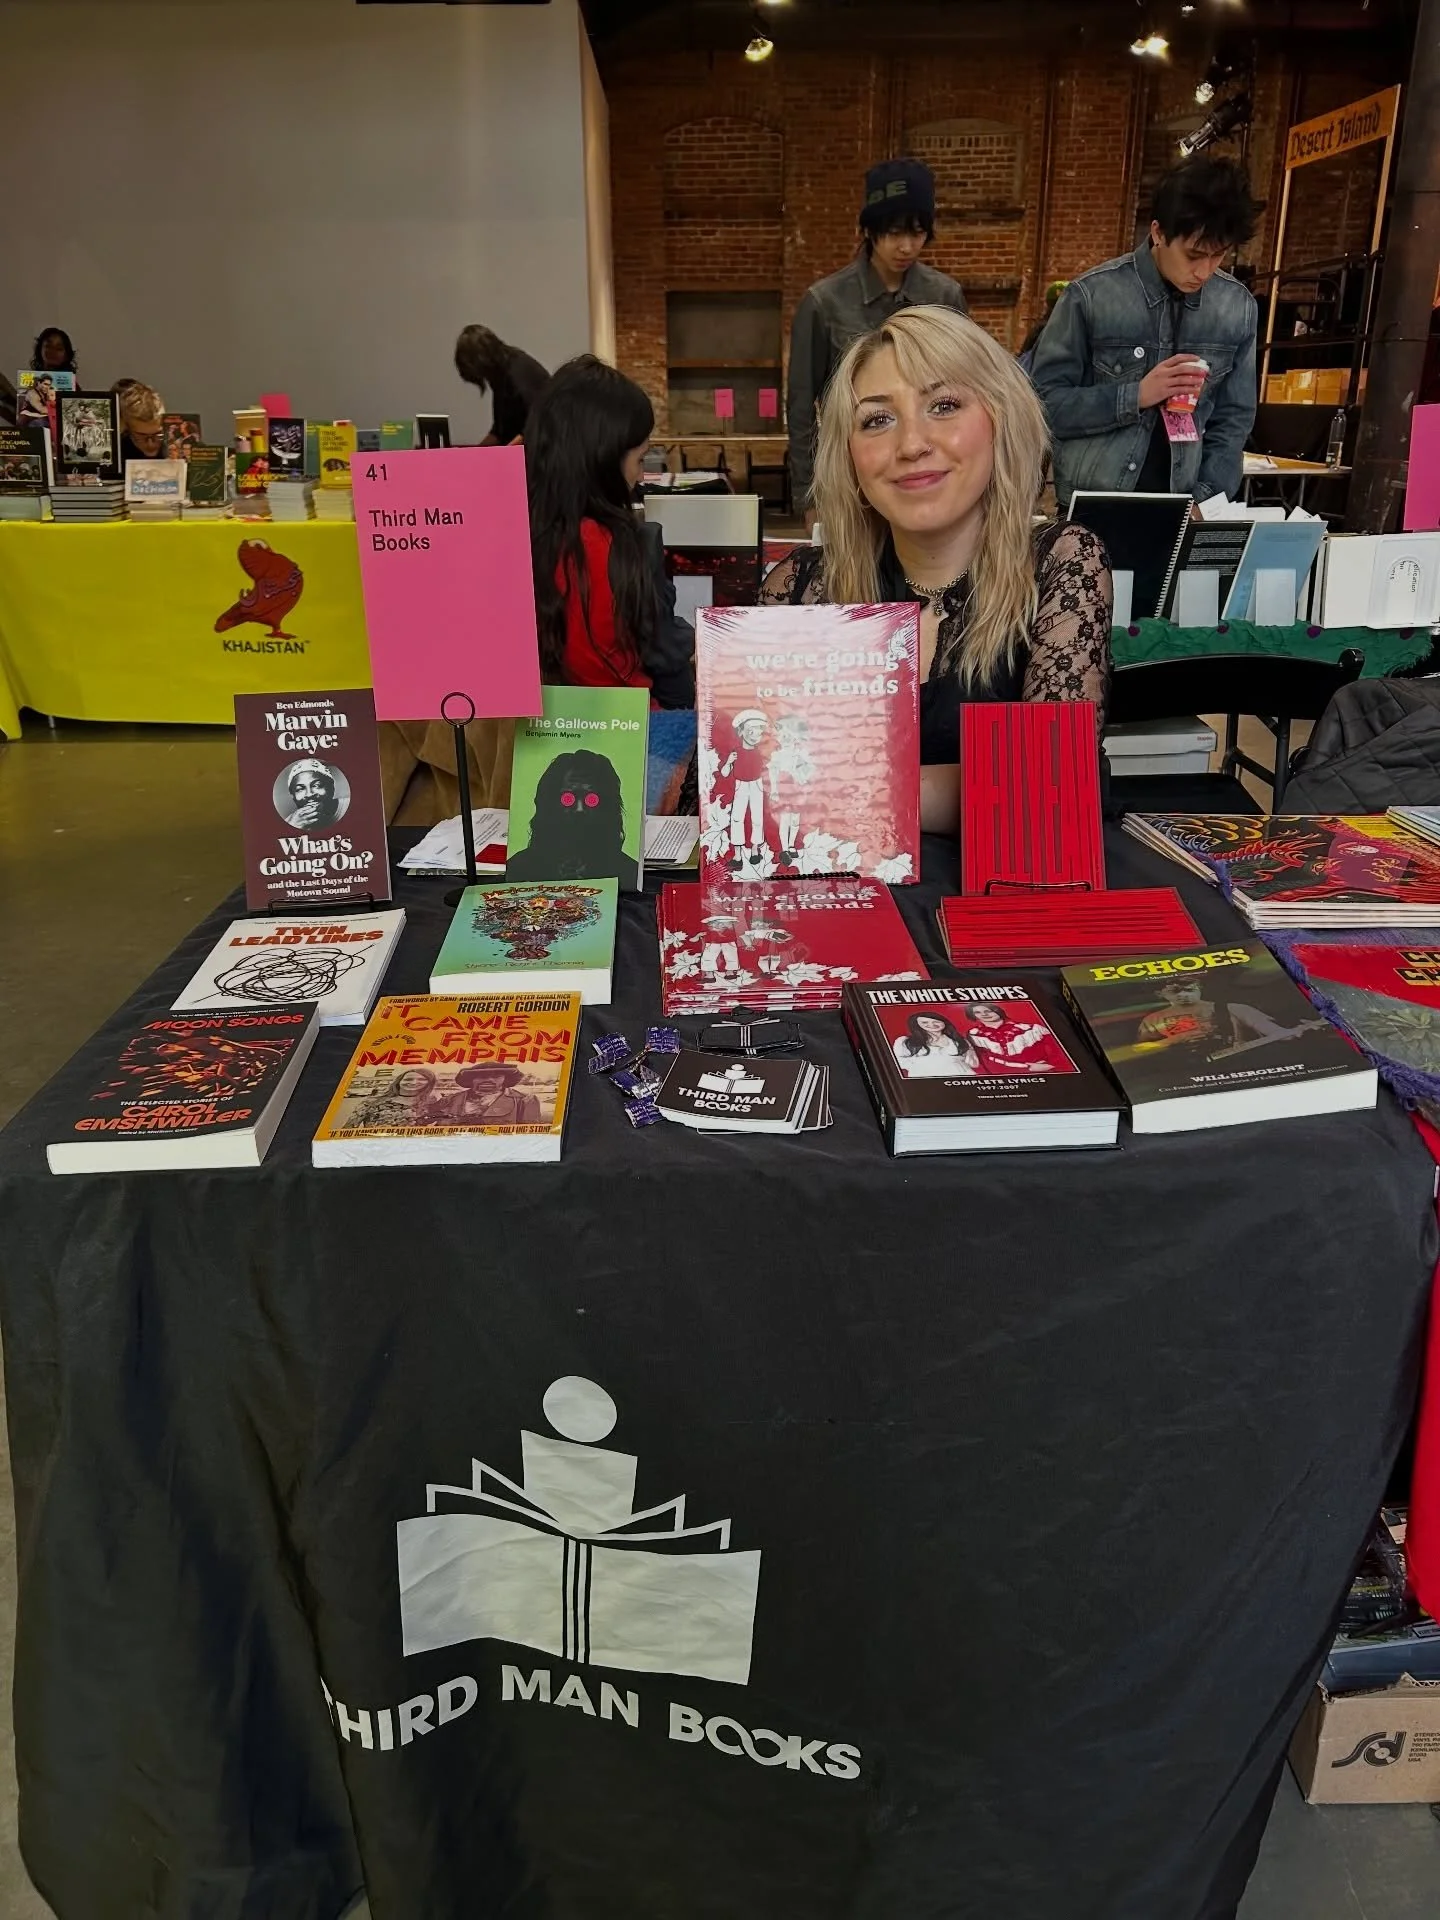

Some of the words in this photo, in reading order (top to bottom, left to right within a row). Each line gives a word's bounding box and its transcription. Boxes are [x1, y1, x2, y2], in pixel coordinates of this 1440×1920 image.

[1290, 121, 1335, 162] Desert
[1337, 101, 1382, 150] Island
[366, 463, 388, 481] 41
[368, 508, 417, 527] Third
[424, 507, 464, 526] Man
[372, 532, 431, 552] Books
[746, 651, 817, 669] we're
[825, 649, 900, 673] going
[756, 686, 773, 697] to
[777, 683, 797, 697] be
[802, 674, 899, 697] friends
[276, 701, 293, 710] Ben
[294, 699, 335, 709] Edmonds
[265, 709, 349, 732] Marvin
[527, 717, 551, 728] The
[554, 717, 607, 730] Gallows
[611, 718, 640, 731] Pole
[277, 731, 339, 754] Gaye:
[525, 730, 558, 739] Benjamin
[559, 730, 582, 739] Myers
[278, 833, 353, 855] What's
[259, 856, 328, 877] Going
[329, 850, 373, 872] On?
[267, 880, 284, 889] and
[285, 879, 300, 888] the
[301, 878, 320, 888] Last
[321, 877, 343, 888] Days
[343, 875, 353, 885] of
[354, 875, 369, 884] the
[286, 888, 322, 898] Motown
[322, 886, 351, 896] Sound
[713, 893, 790, 903] we're
[774, 900, 876, 911] friends
[228, 935, 297, 947] LEAD
[304, 930, 385, 945] LINES
[273, 925, 348, 936] TWIN
[1088, 947, 1252, 982] ECHOES
[865, 988, 900, 1005] THE
[898, 987, 960, 1003] WHITE
[954, 984, 1030, 1002] STRIPES
[379, 1004, 422, 1020] IT
[456, 1001, 514, 1014] ROBERT
[514, 1000, 572, 1012] GORDON
[140, 1018, 225, 1031] MOON
[226, 1014, 306, 1028] SONGS
[402, 1014, 532, 1031] CAME
[440, 1030, 572, 1048] FROM
[356, 1045, 568, 1068] MEMPHIS
[943, 1078, 1005, 1088] COMPLETE
[1006, 1076, 1047, 1086] LYRICS
[1189, 1072, 1231, 1083] WILL
[1230, 1064, 1306, 1079] SERGEANT
[137, 1098, 181, 1106] SELECTED
[181, 1096, 219, 1105] STORIES
[220, 1095, 235, 1103] OF
[677, 1085, 731, 1103] THIRD
[733, 1093, 777, 1106] MAN
[121, 1101, 220, 1119] CAROL
[692, 1100, 753, 1114] BOOKS
[73, 1108, 254, 1132] EMSHWILLER
[339, 1129, 355, 1138] YOU
[406, 1127, 424, 1136] THIS
[499, 1662, 641, 1729] MAN
[667, 1699, 864, 1780] BOOKS
